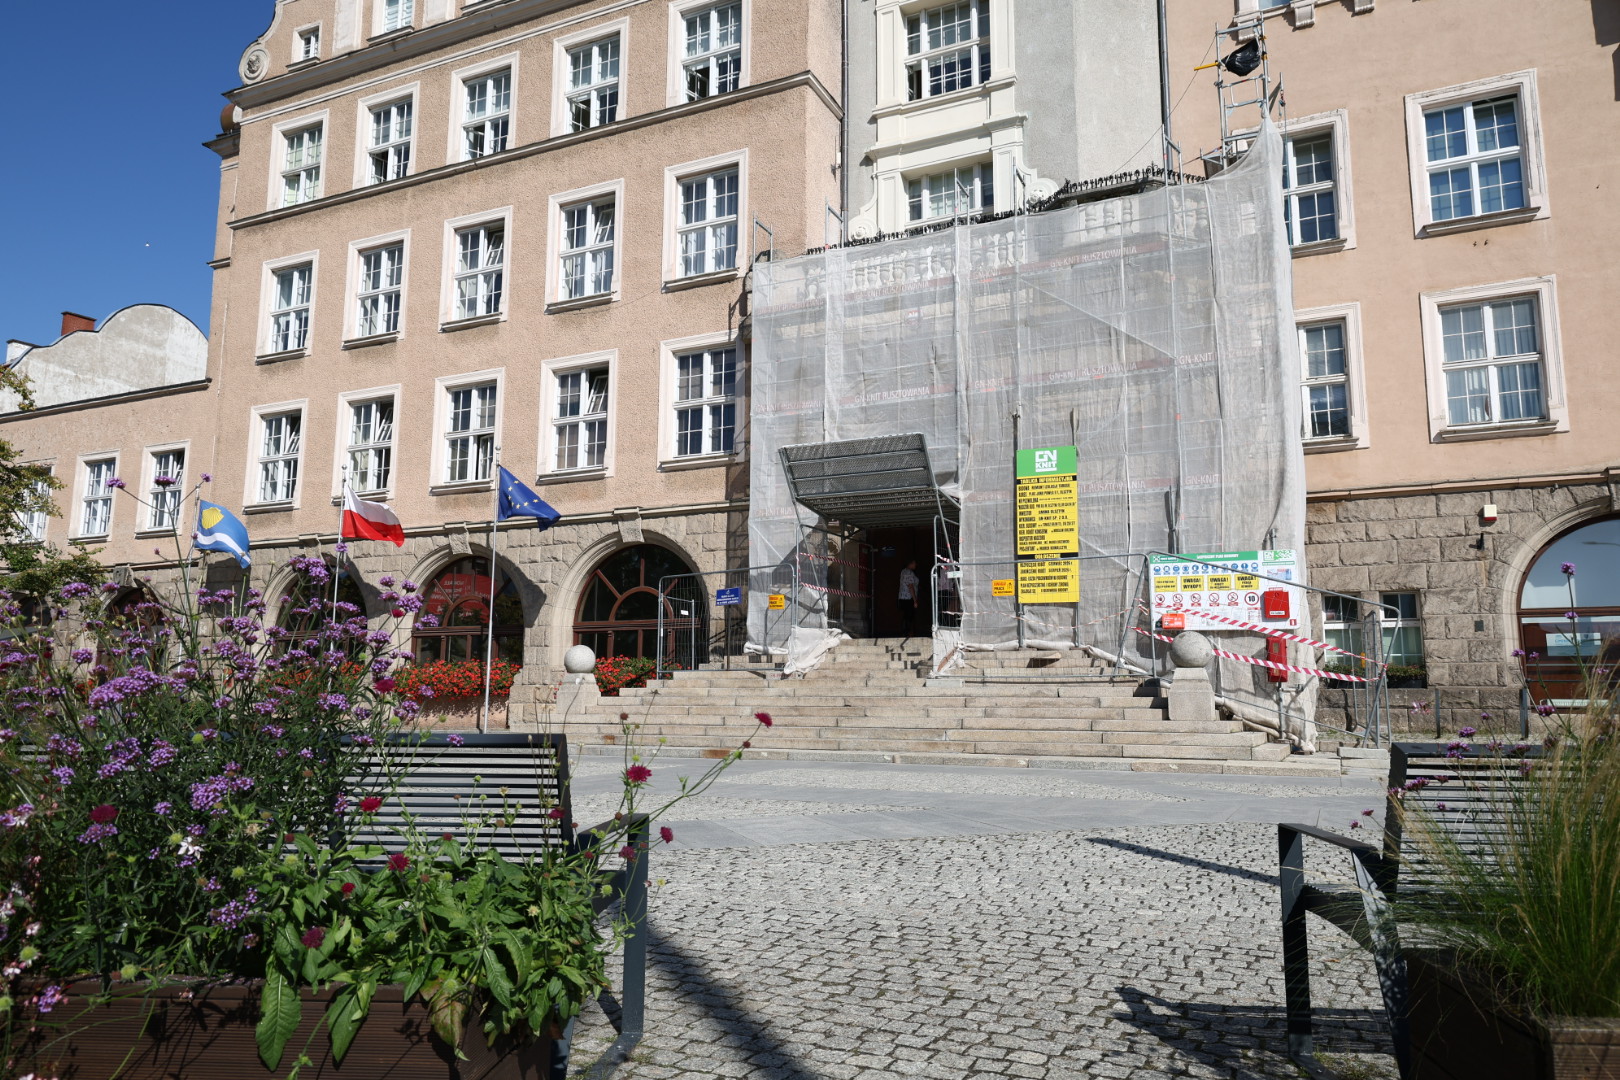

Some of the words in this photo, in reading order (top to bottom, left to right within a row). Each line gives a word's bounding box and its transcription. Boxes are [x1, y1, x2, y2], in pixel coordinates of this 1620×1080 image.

[1178, 351, 1213, 365] GN-KNIT
[882, 387, 930, 401] RUSZTOWANIA
[1035, 449, 1057, 462] GN
[1035, 460, 1057, 469] KNIT
